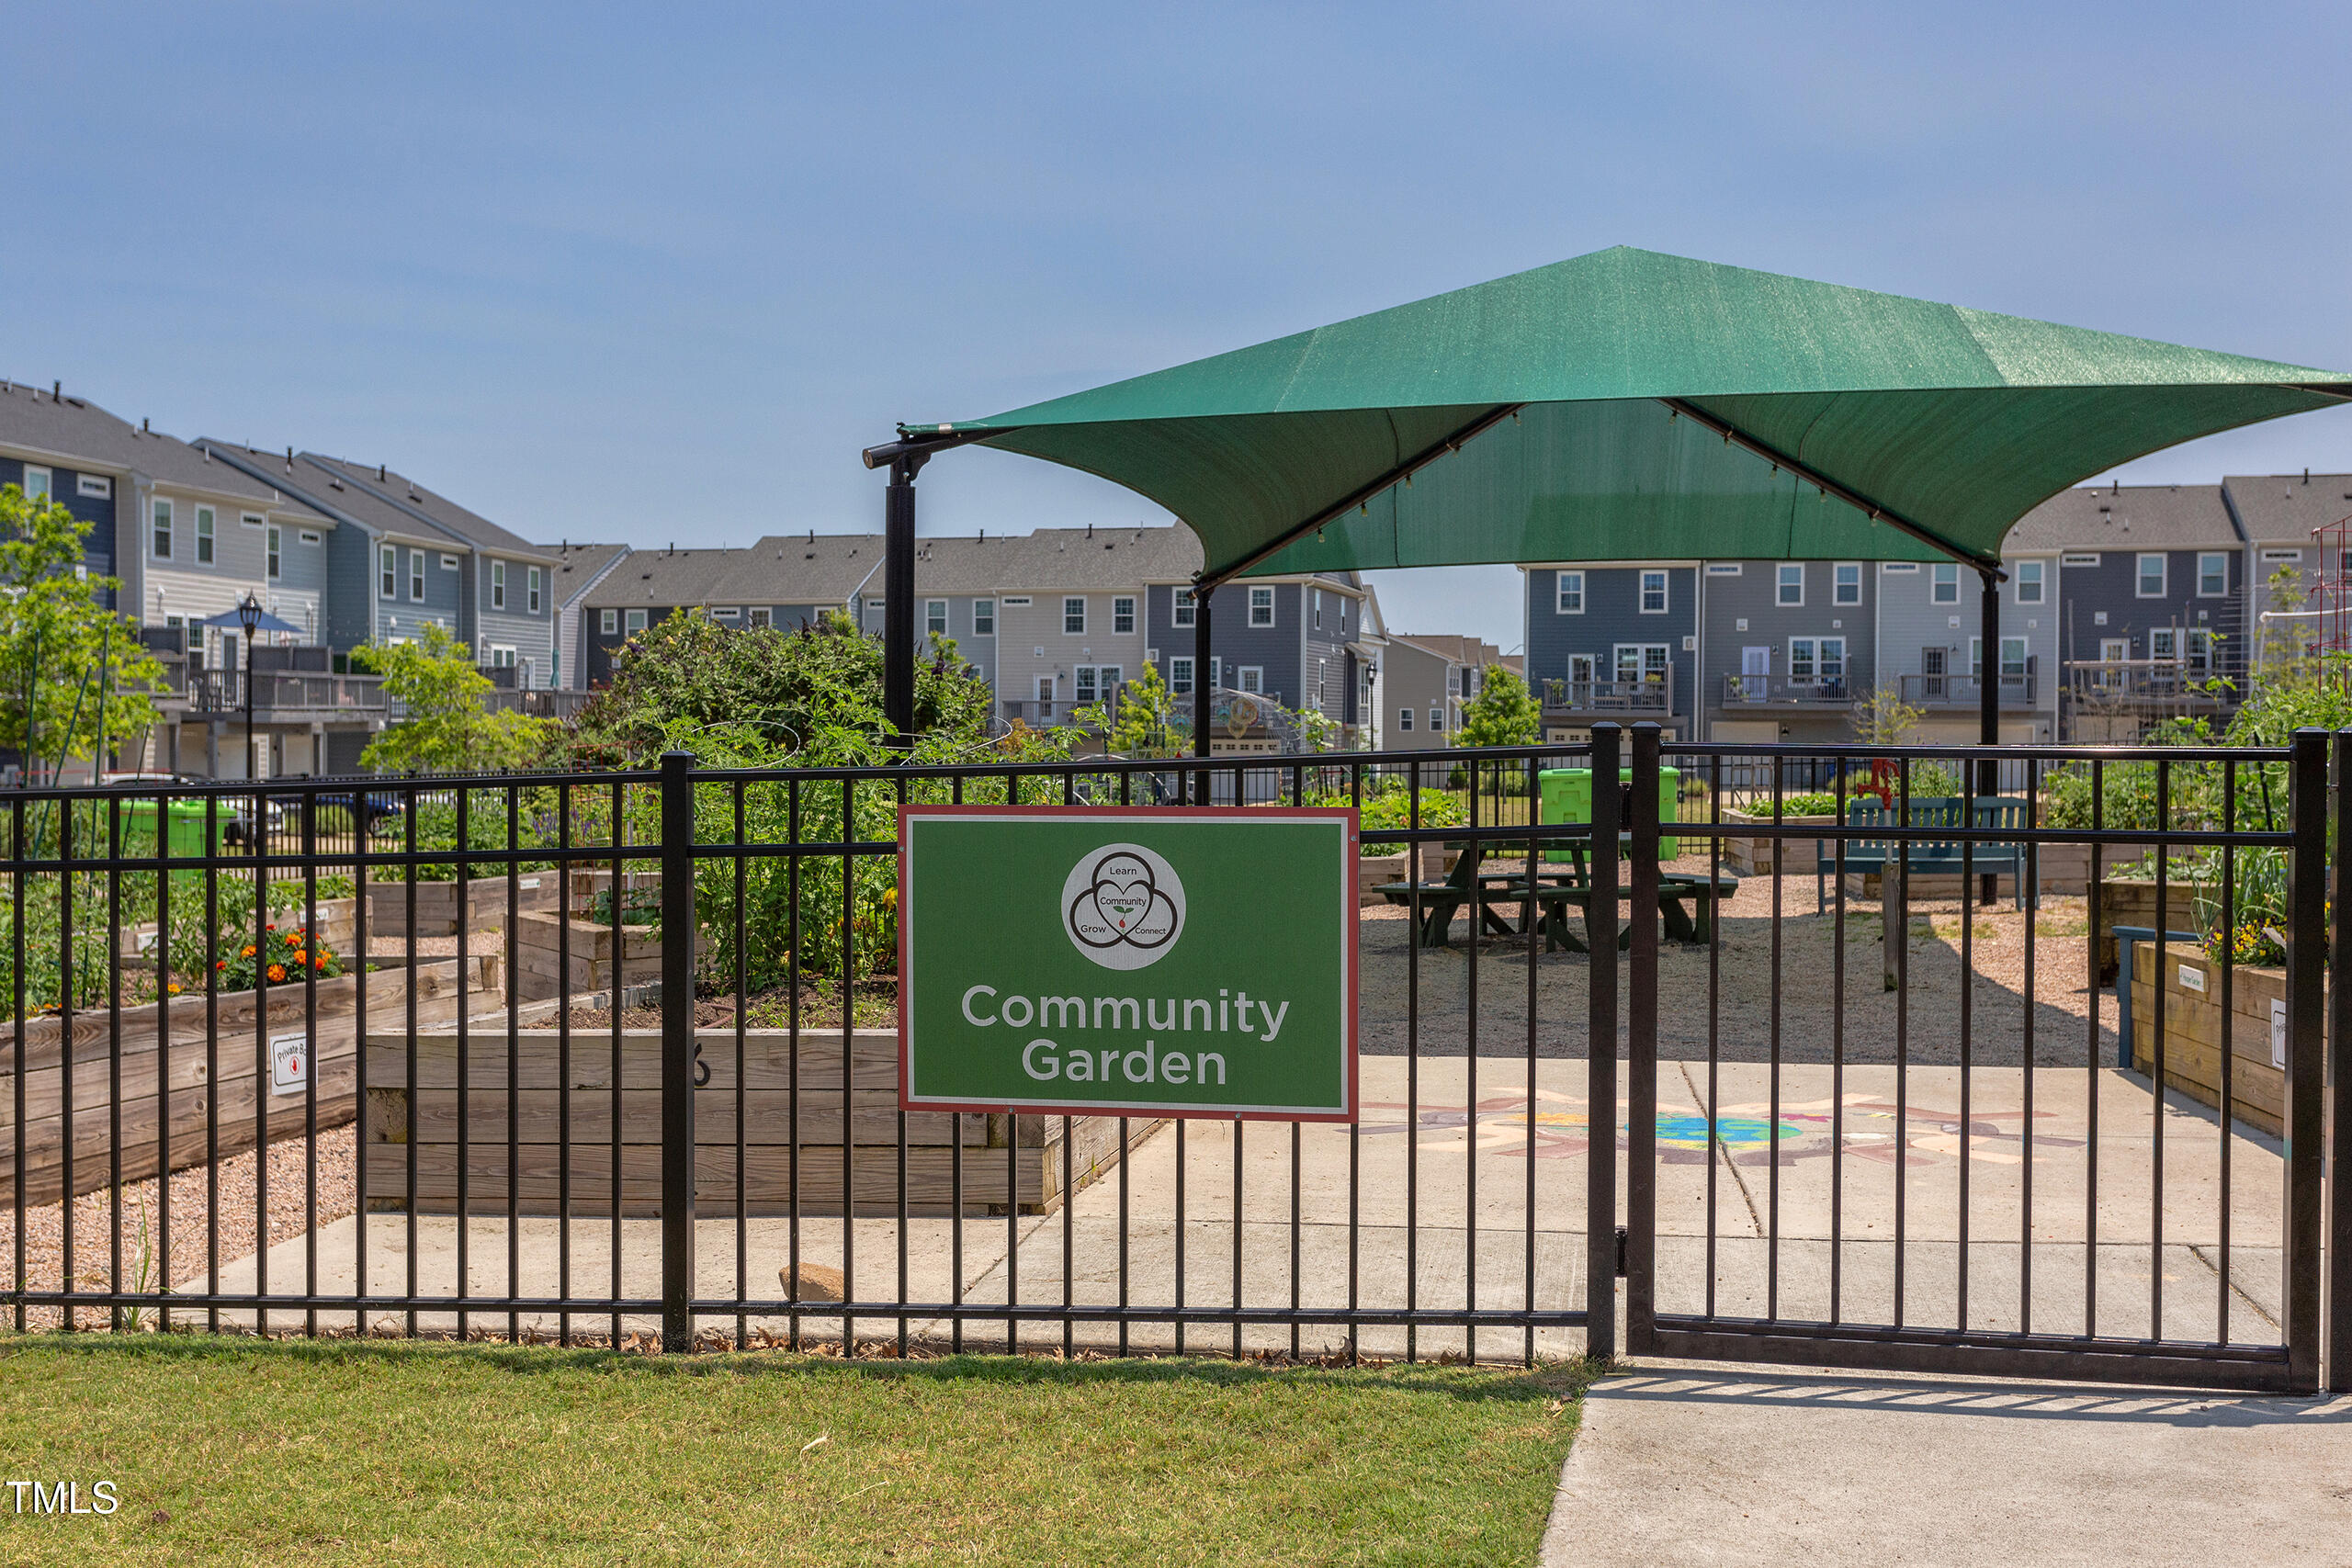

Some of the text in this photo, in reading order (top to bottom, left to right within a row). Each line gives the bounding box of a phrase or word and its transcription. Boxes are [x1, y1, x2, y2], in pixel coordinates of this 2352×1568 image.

[1109, 866, 1137, 875] Learn
[1100, 897, 1148, 907] Community
[1080, 924, 1107, 933] Grow
[1135, 927, 1167, 935] Connect
[961, 985, 1290, 1043] Community
[277, 1044, 299, 1063] Private
[1022, 1038, 1227, 1085] Garden
